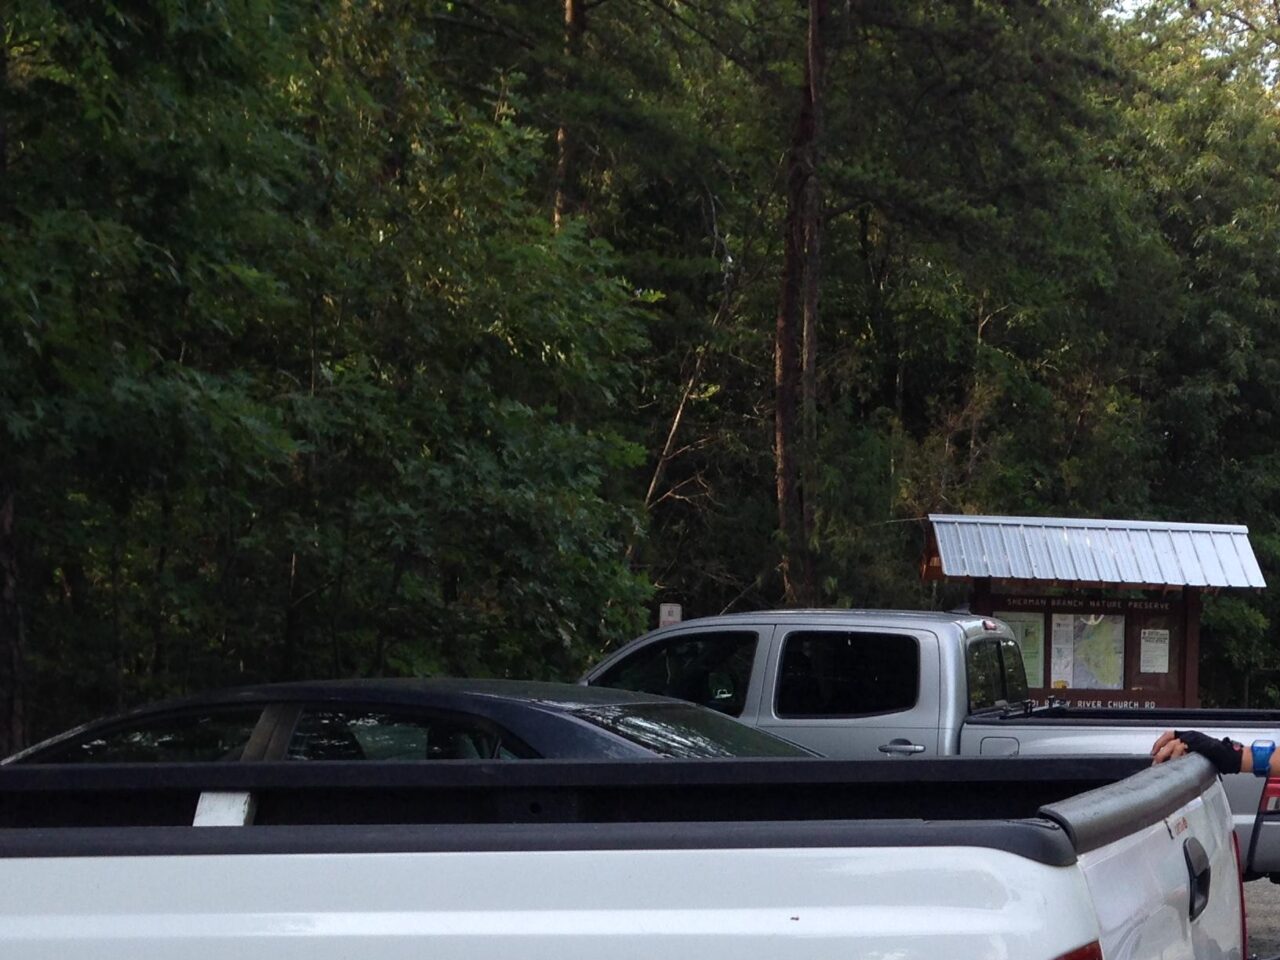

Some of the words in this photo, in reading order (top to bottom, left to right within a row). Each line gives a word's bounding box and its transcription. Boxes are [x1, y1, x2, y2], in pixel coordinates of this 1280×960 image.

[1006, 598, 1047, 607] SHERMAN
[1051, 599, 1084, 608] BRANCH
[1089, 600, 1122, 609] NATURE
[1128, 601, 1170, 610] PRESERVE
[1077, 700, 1102, 709] RIVER
[1107, 700, 1139, 709] CHURCH
